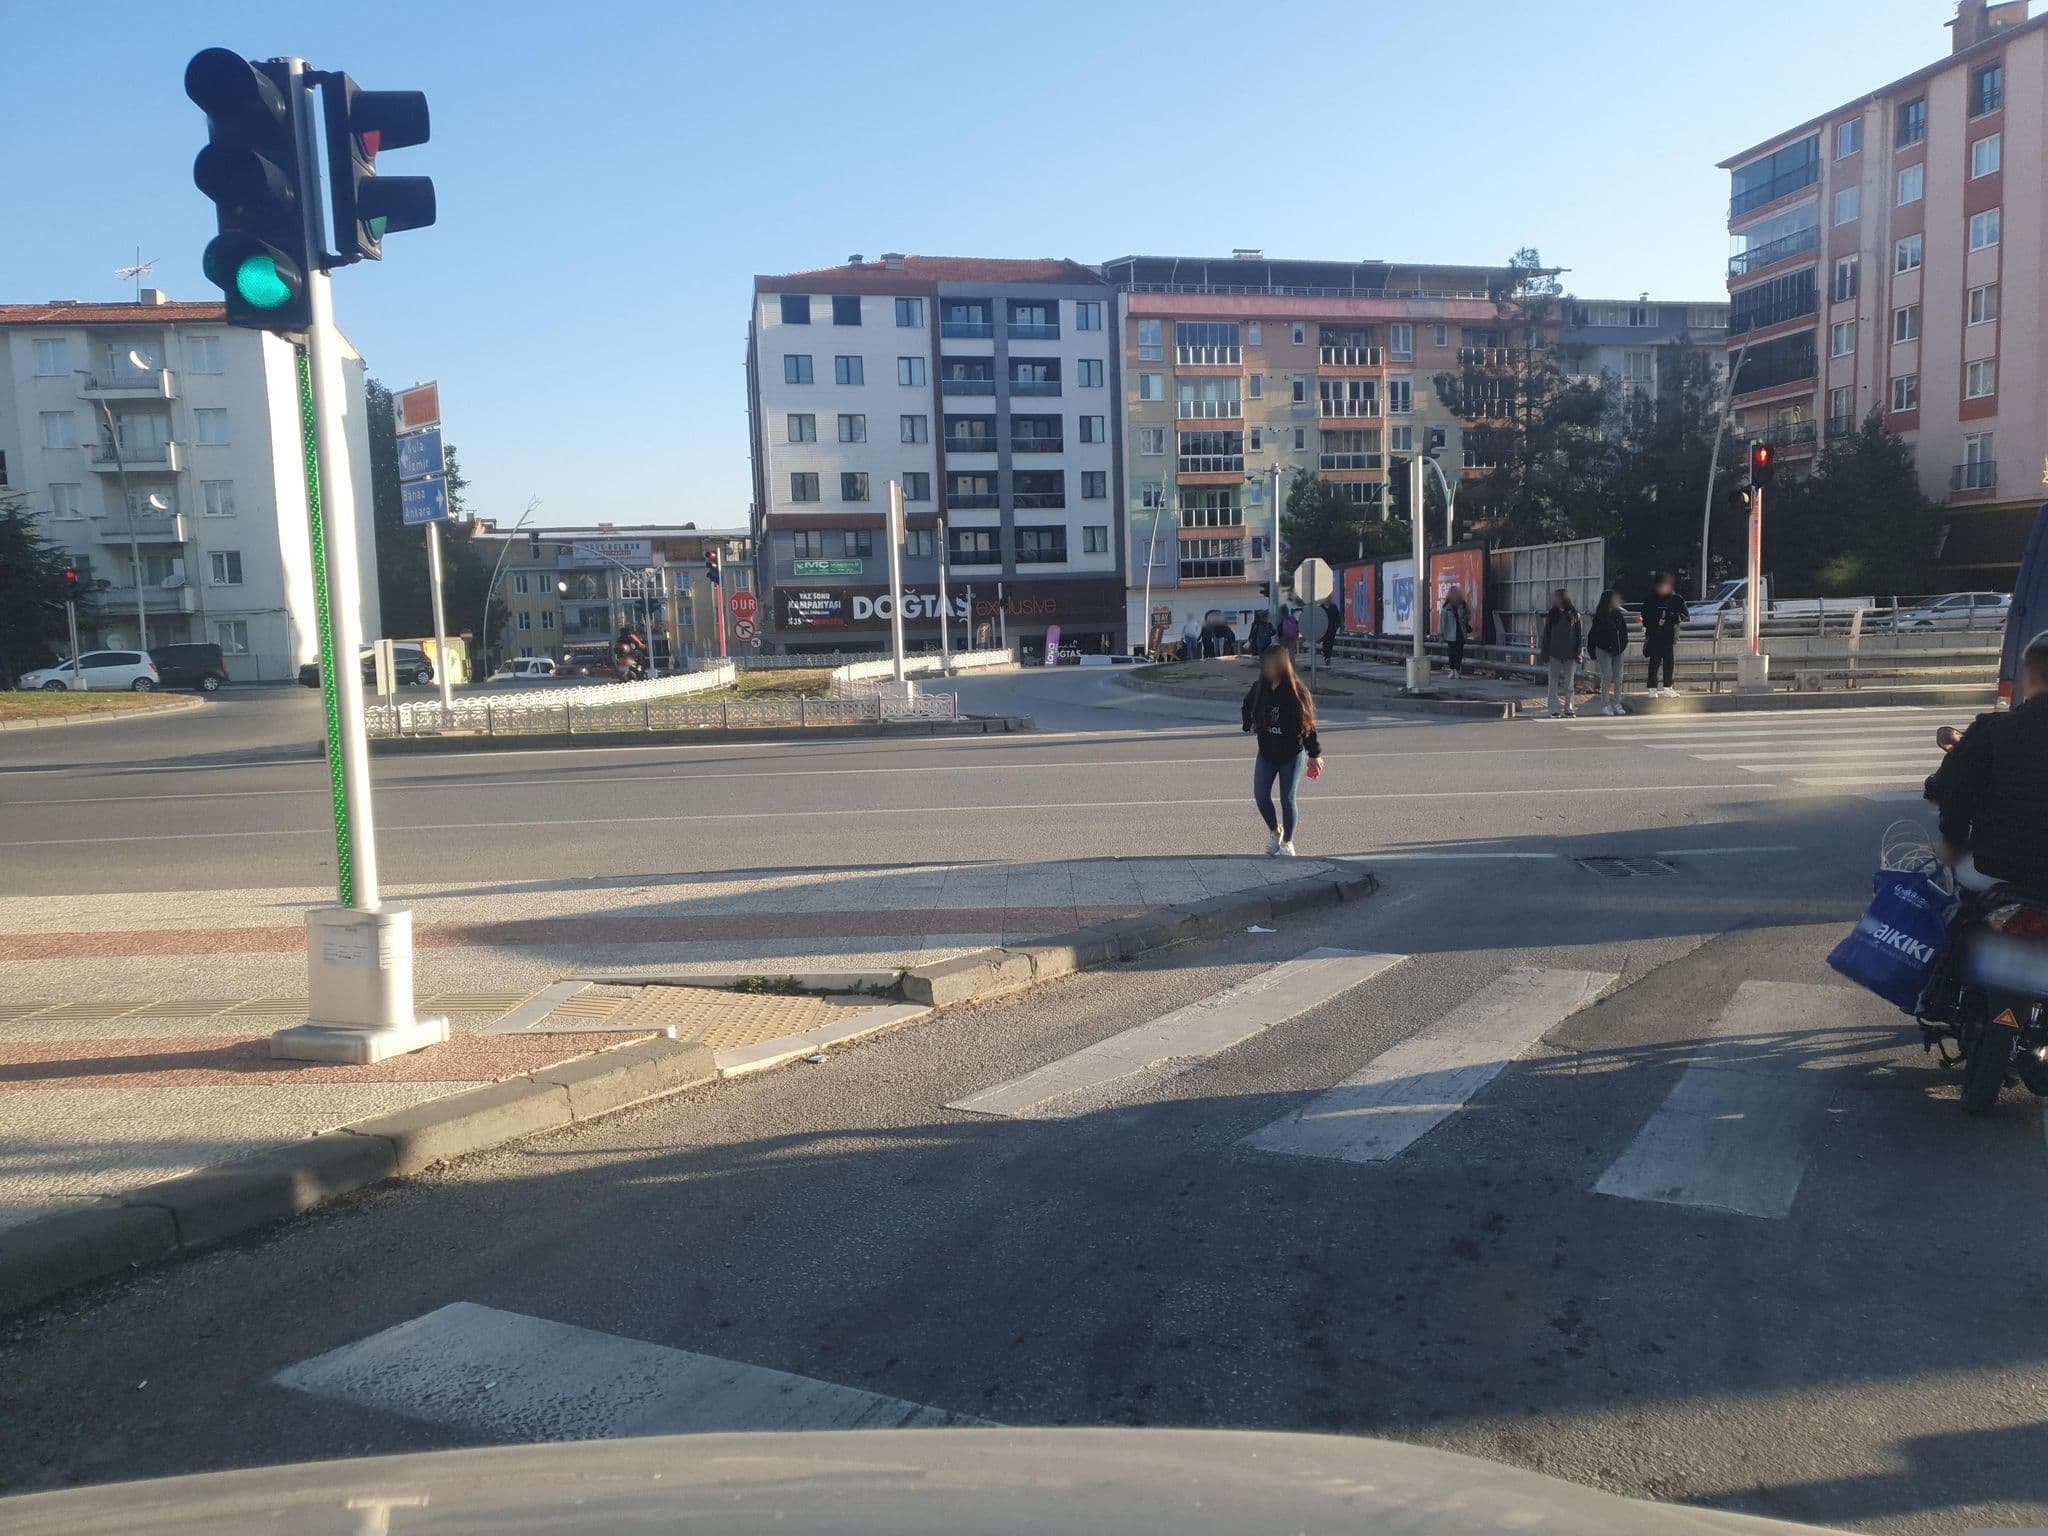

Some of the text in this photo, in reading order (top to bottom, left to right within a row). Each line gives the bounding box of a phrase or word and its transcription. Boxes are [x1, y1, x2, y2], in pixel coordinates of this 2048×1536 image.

[407, 440, 424, 454] Kula
[403, 489, 426, 502] Banaz
[405, 507, 431, 520] Ankara
[731, 599, 756, 611] DUR
[976, 595, 1057, 616] exlusive
